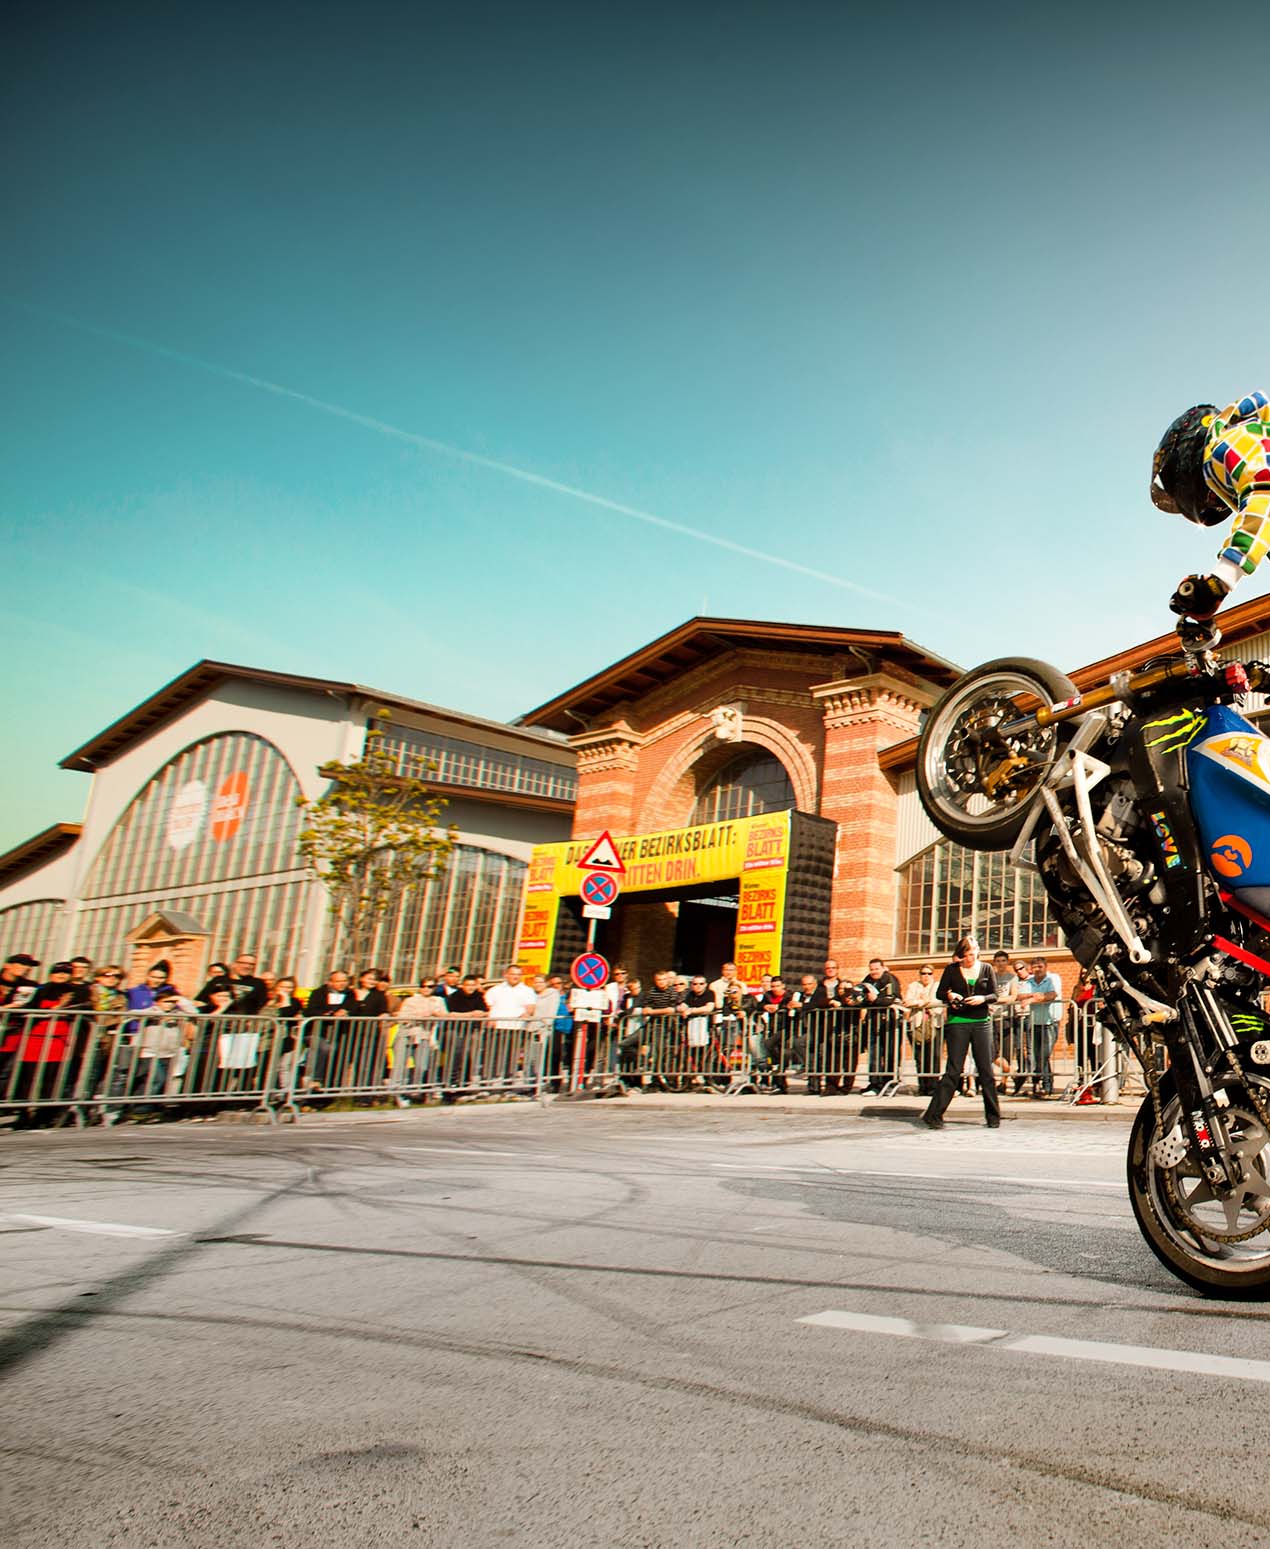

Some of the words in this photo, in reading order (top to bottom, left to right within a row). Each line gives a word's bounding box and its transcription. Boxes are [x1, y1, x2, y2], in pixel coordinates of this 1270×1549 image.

[639, 825, 736, 859] BEZIRKSBLATT:
[665, 858, 700, 881] DRIN.
[741, 902, 775, 921] BLATT
